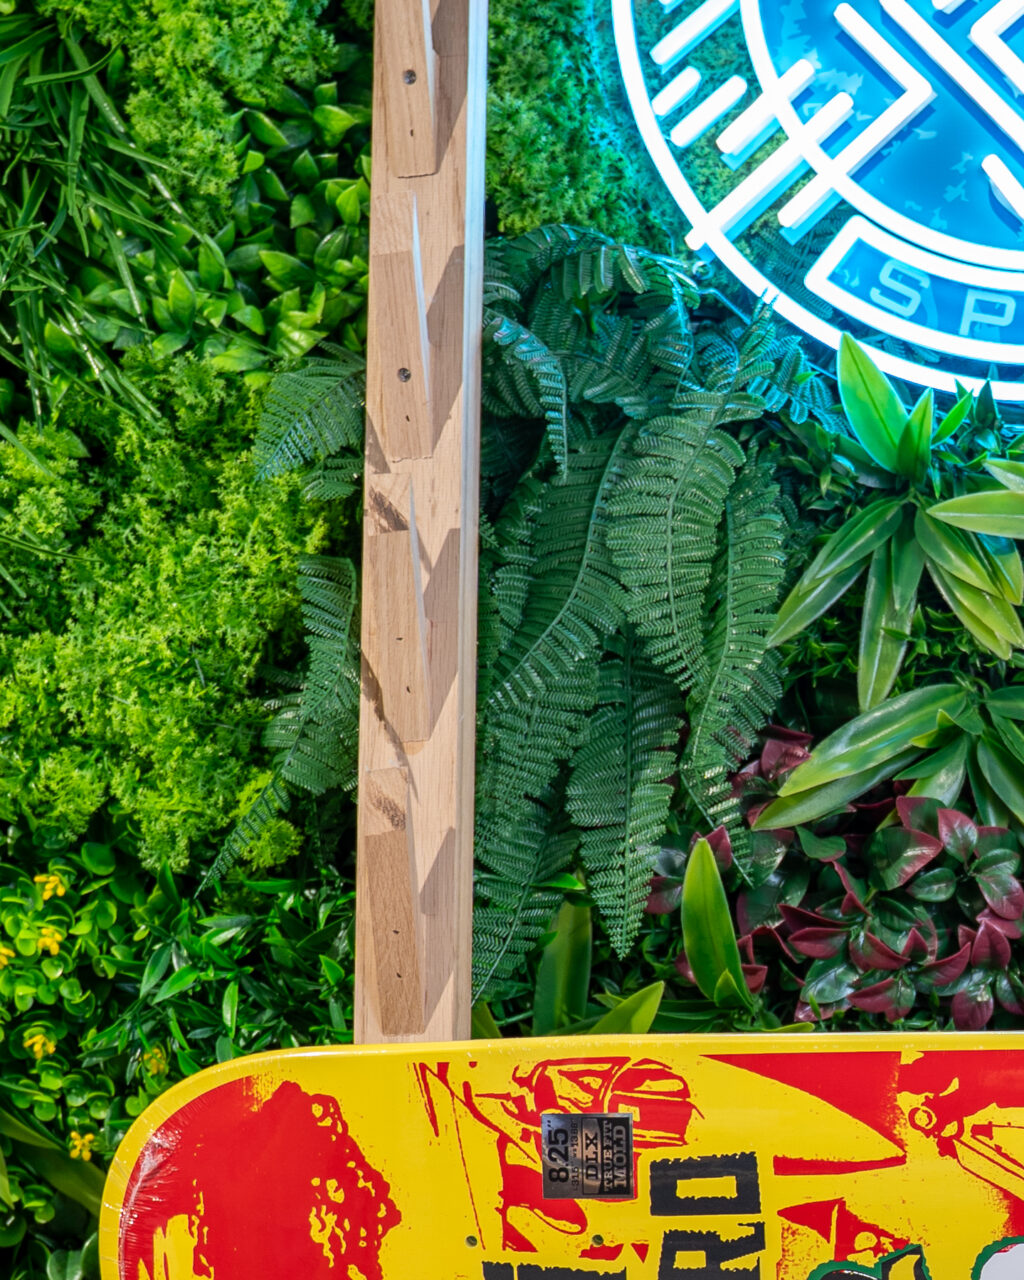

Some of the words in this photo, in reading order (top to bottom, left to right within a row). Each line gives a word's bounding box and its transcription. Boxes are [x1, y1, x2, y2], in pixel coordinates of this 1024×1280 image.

[603, 1119, 613, 1147] FIT
[585, 1132, 599, 1180] DLX
[603, 1149, 613, 1192] TRUE
[613, 1125, 627, 1188] MOLD
